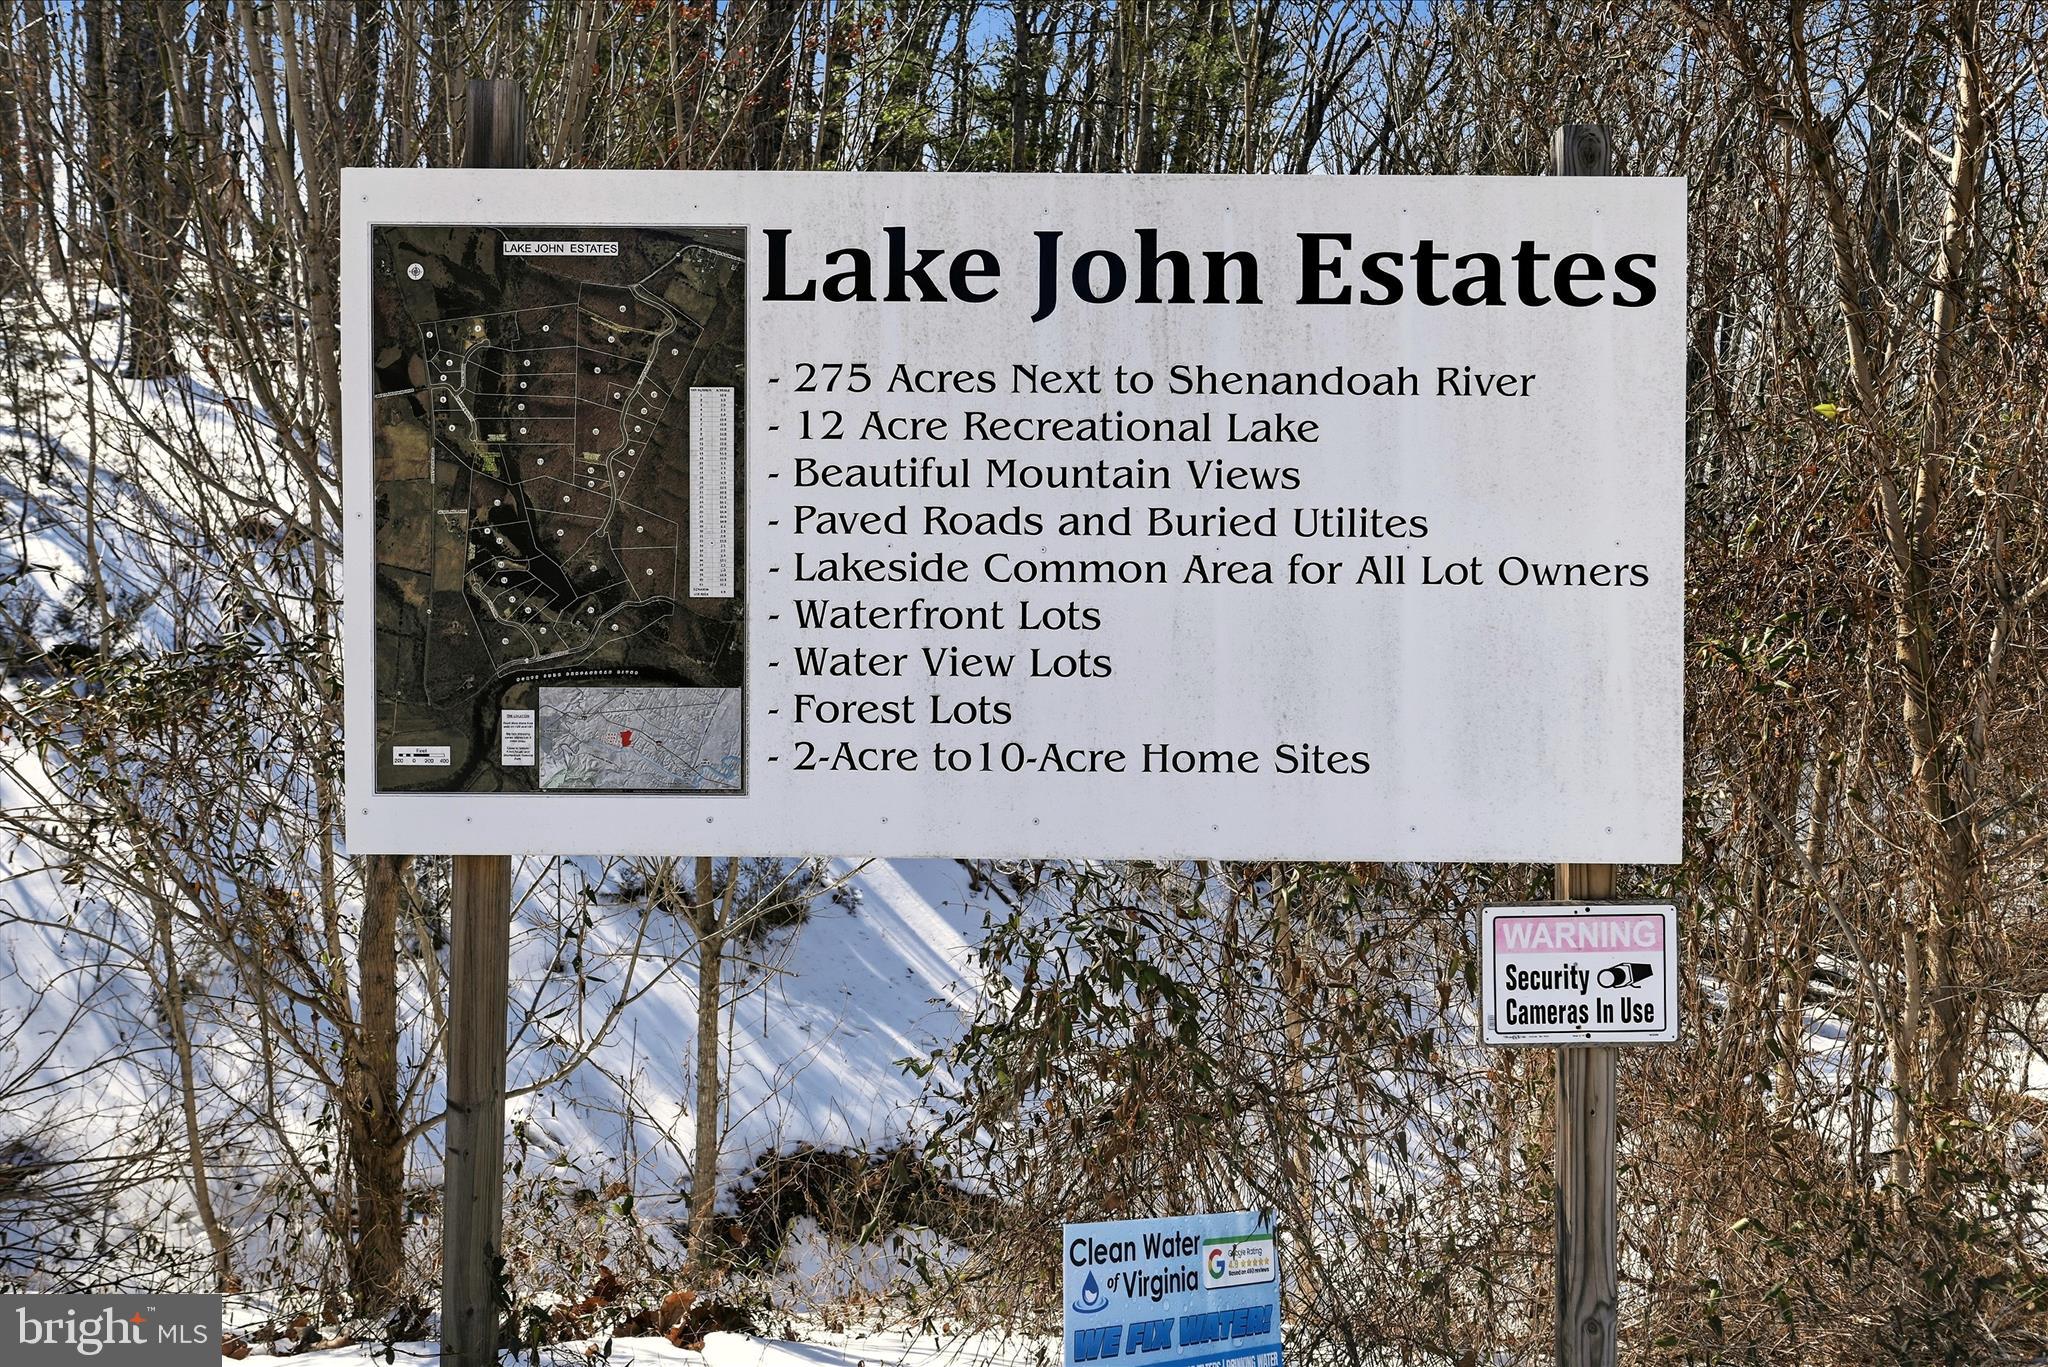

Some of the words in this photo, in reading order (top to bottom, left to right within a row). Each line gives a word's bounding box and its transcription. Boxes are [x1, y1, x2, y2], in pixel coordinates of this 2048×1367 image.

[504, 244, 531, 253] LAKE
[535, 244, 564, 253] JOHN
[570, 244, 617, 253] ESTATES
[763, 227, 1000, 303] Lake
[1031, 229, 1263, 323] John
[1296, 233, 1656, 307] Estates
[795, 363, 871, 392] 275
[887, 364, 996, 393] Acres
[1012, 365, 1101, 393] Next
[1115, 366, 1153, 394] to
[1169, 365, 1419, 395] Shenandoah
[1437, 366, 1536, 396] River
[799, 410, 843, 439] 12
[860, 411, 947, 440] Acre
[964, 411, 1211, 441] Recreational
[1228, 413, 1319, 442] Lake
[795, 457, 969, 487] Beautiful
[987, 459, 1170, 488] Mountain
[1187, 459, 1300, 489] Views
[794, 506, 907, 534] Paved
[924, 506, 1043, 535] Roads
[1059, 507, 1131, 535] and
[1149, 507, 1276, 536] Buried
[1294, 507, 1428, 538] Utilites
[795, 552, 968, 582] Lakeside
[985, 554, 1167, 583] Common
[1183, 555, 1273, 584] Area
[1288, 554, 1342, 584] for
[1356, 555, 1405, 584] All
[1422, 556, 1483, 585] Lot
[1499, 557, 1648, 586] Owners
[794, 598, 1004, 629] Waterfront
[1019, 601, 1100, 630] Lots
[795, 647, 908, 676] Water
[922, 647, 1015, 677] View
[1031, 649, 1111, 677] Lots
[795, 694, 915, 723] Forest
[931, 695, 1011, 724] Lots
[794, 742, 918, 771] 2-Acre
[1142, 744, 1259, 773] Home
[1275, 743, 1369, 774] Sites
[1503, 920, 1657, 949] WARNING
[1506, 963, 1589, 995] Security
[1506, 998, 1589, 1025] Cameras
[1596, 997, 1614, 1024] In
[1621, 997, 1654, 1024] Use
[1070, 1237, 1136, 1267] Clean
[1143, 1231, 1200, 1259] Water
[1228, 1260, 1238, 1268] 4.9
[1247, 1247, 1263, 1256] Rating
[1107, 1272, 1120, 1293] of
[1123, 1265, 1199, 1302] Virginia
[1074, 1325, 1122, 1362] WE
[1125, 1318, 1175, 1354] FIX
[1179, 1304, 1273, 1347] WATER!
[1256, 1351, 1279, 1367] WATER
